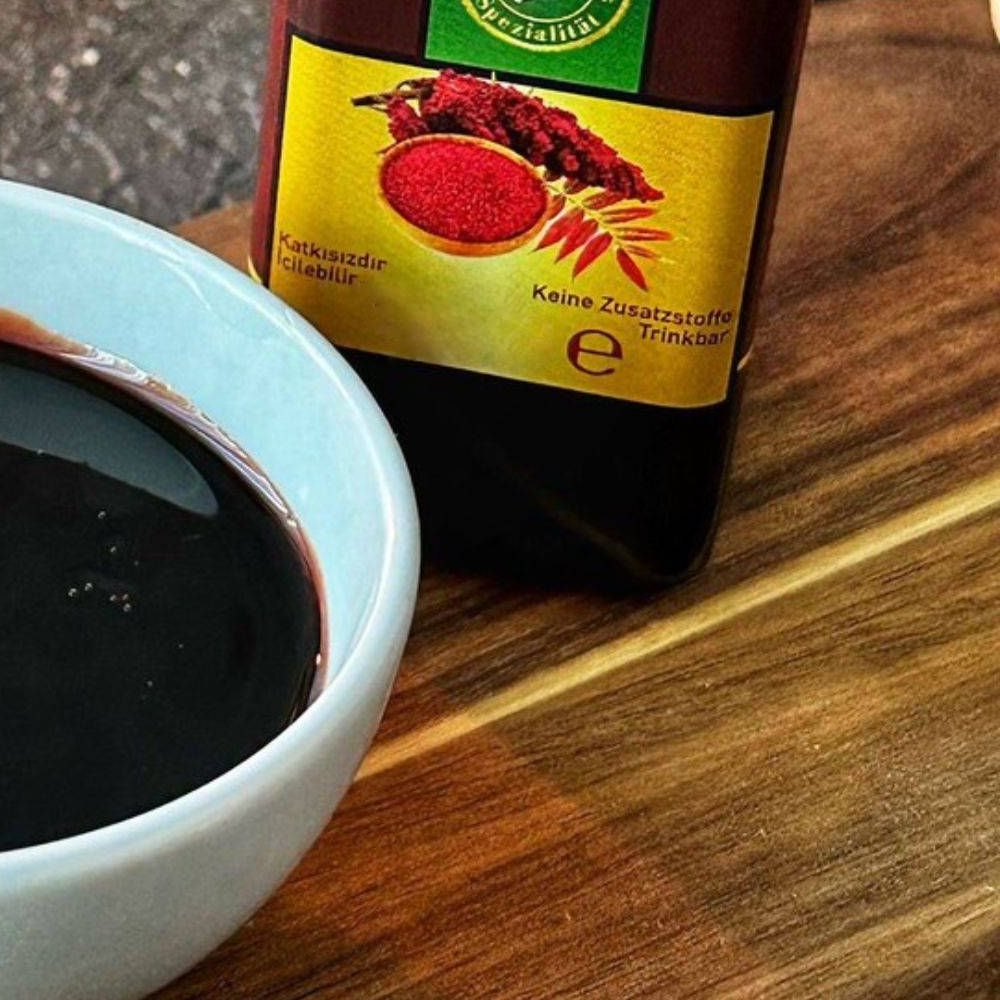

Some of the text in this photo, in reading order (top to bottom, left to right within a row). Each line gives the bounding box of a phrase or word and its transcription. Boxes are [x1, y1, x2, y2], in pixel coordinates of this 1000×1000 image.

[532, 284, 734, 325] Keine Zusatzstoffe
[638, 322, 731, 348] Trinkbar
